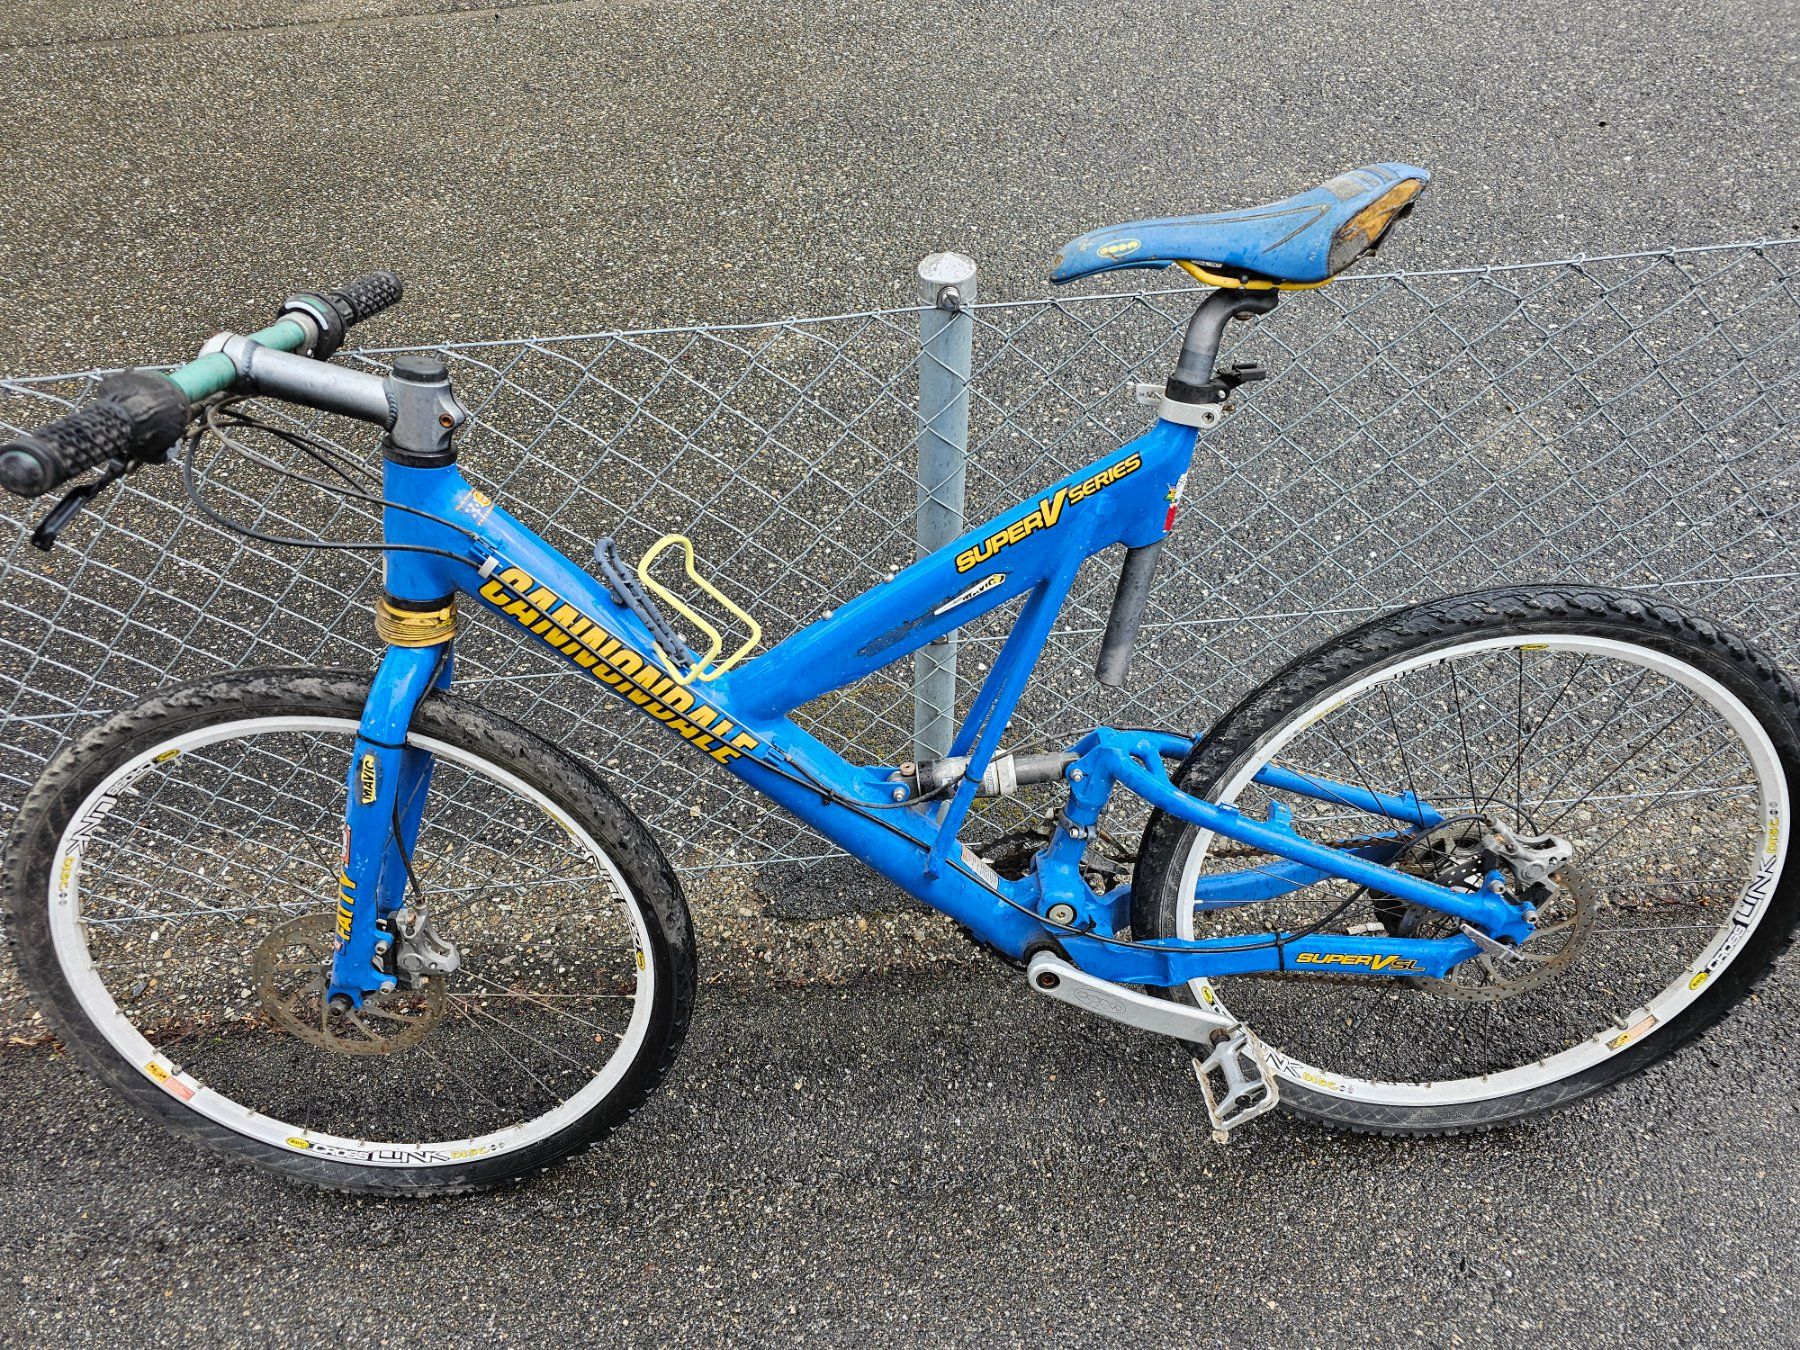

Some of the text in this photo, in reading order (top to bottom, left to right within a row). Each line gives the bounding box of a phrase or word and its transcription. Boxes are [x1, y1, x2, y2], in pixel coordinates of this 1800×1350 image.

[1068, 452, 1142, 506] SERIES
[479, 567, 760, 765] CANNONDALE
[363, 759, 376, 801] MAVIC
[1766, 816, 1780, 854] DISC
[59, 856, 75, 891] DISC
[337, 871, 357, 942] FATTY
[1389, 959, 1425, 972] SL
[1302, 1071, 1339, 1091] DISC
[312, 1143, 369, 1160] CROSS
[371, 1150, 450, 1163] LINK
[450, 1146, 489, 1159] DISC
